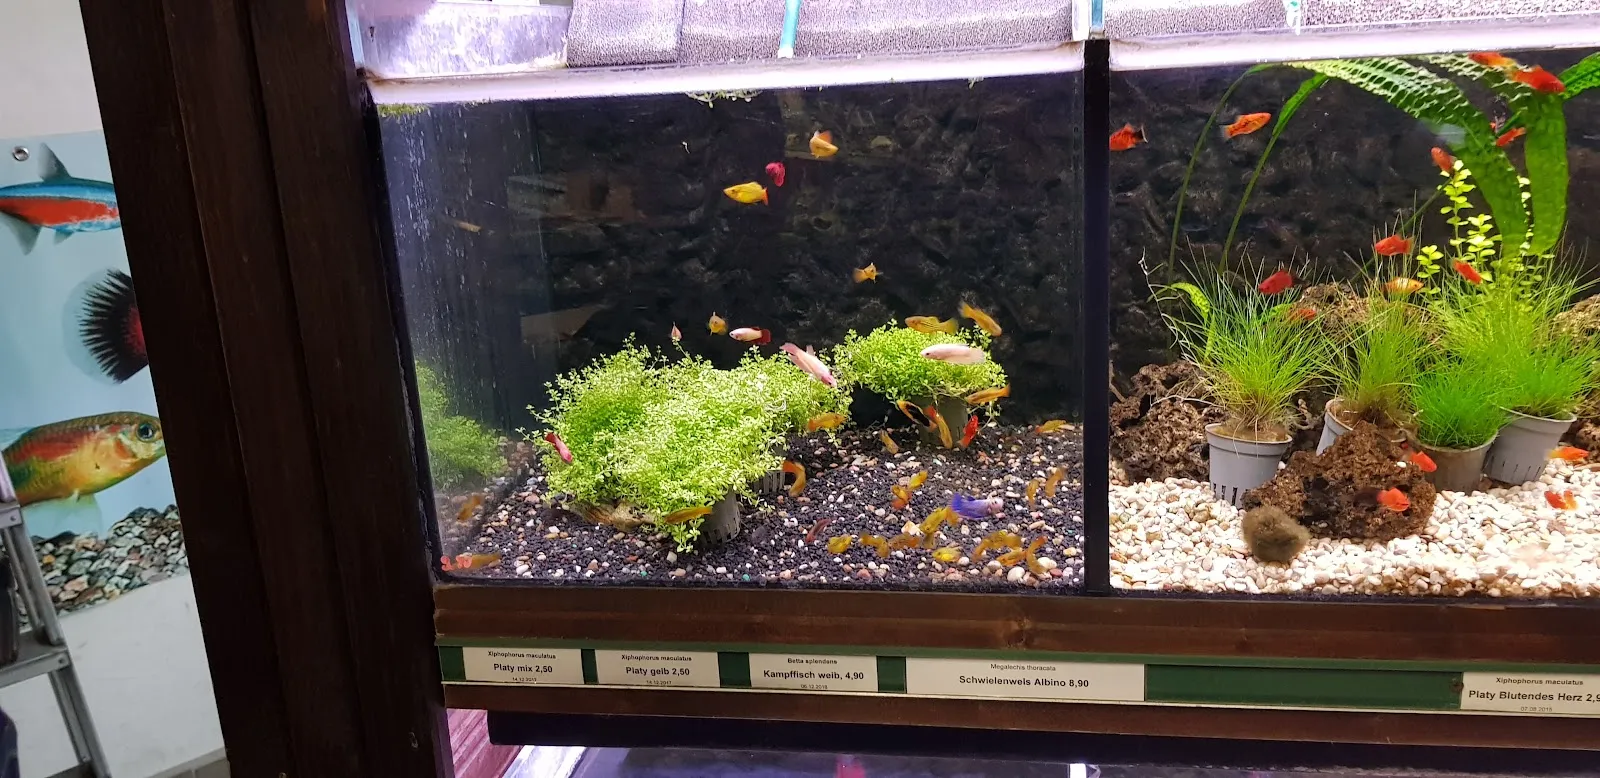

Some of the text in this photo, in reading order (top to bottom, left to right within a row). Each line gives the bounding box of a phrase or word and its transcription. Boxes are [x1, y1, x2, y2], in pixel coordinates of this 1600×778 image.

[488, 650, 525, 658] Xiphophorus
[493, 663, 553, 674] Platy mix 2,50
[625, 666, 690, 676] Platy gelb 2,50
[990, 663, 1026, 671] Megalechis
[763, 669, 864, 681] Kampffisch weib, 4,90
[959, 675, 1089, 688] Schwielenwels Albino 8,90
[1495, 677, 1543, 685] Xiphophorus
[1468, 690, 1496, 701] Platy
[1499, 691, 1554, 701] Blutendes
[1558, 692, 1583, 702] Herz
